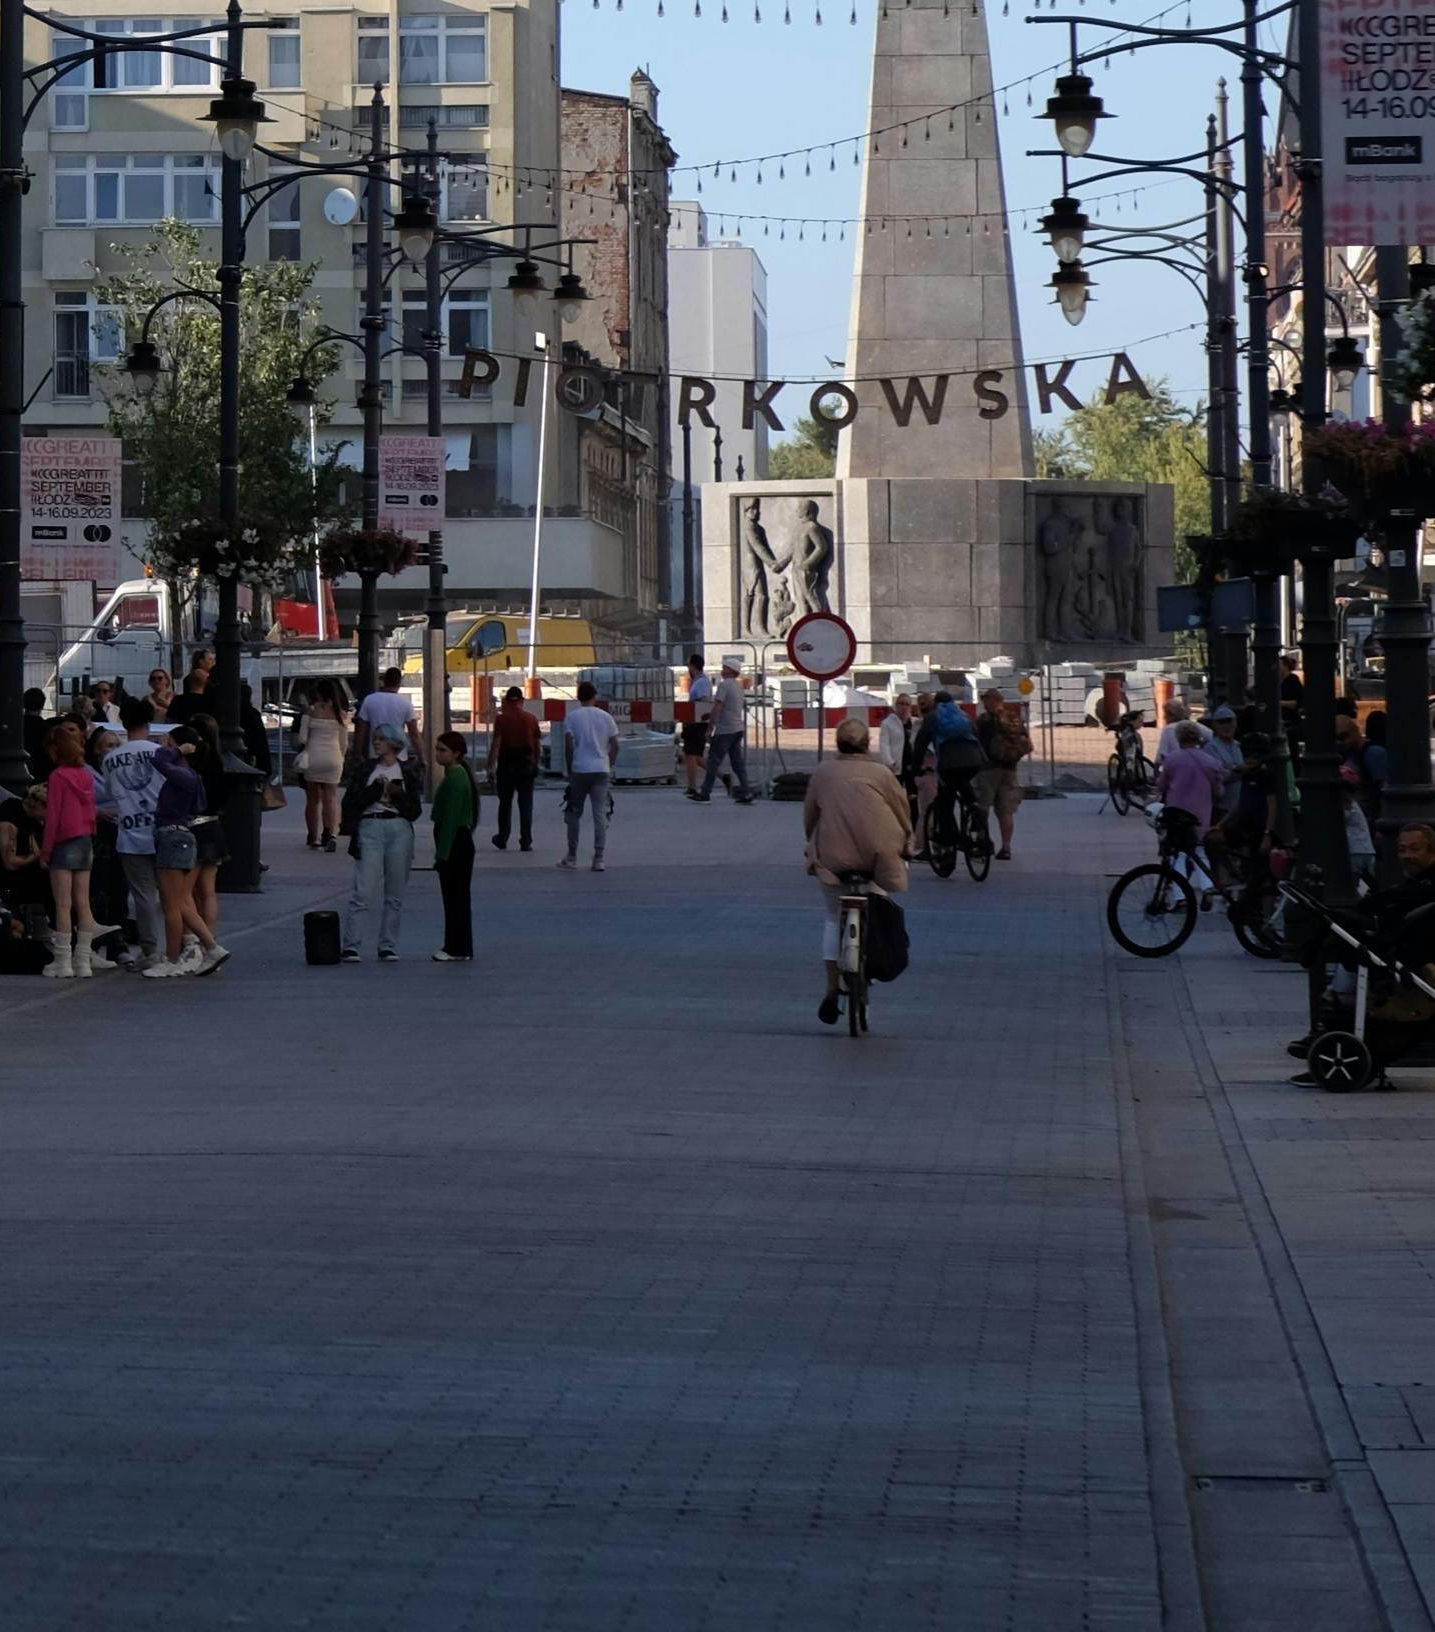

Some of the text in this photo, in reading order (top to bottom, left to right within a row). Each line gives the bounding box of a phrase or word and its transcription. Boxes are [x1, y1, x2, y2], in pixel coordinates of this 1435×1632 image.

[1342, 42, 1435, 65] SEPTE
[1352, 144, 1416, 157] mBank
[459, 346, 1152, 432] PIOTRKOWSKA
[31, 481, 111, 493] SEPTEMBER
[31, 507, 112, 519] 14-16.09.2023
